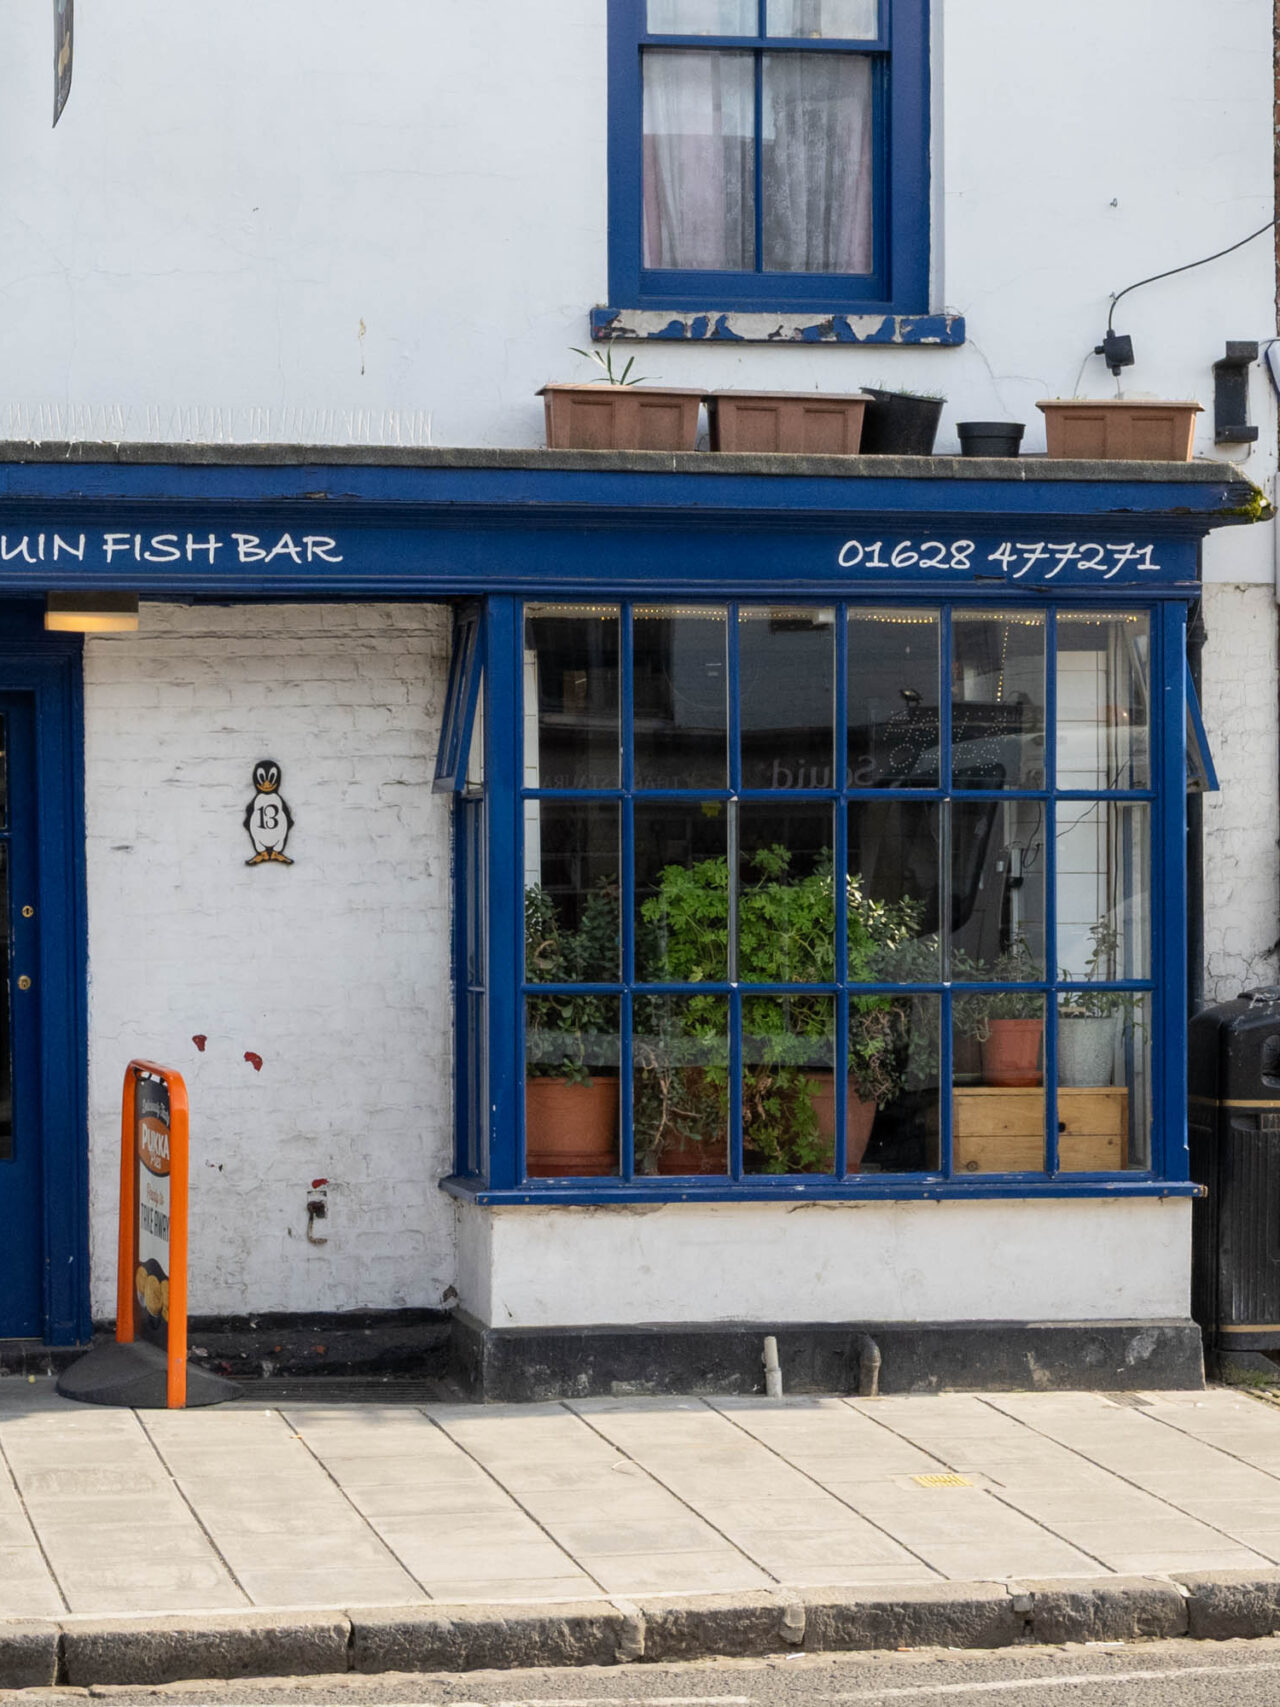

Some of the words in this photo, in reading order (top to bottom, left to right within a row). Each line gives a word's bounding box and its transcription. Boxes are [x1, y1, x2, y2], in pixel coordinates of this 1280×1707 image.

[102, 532, 224, 564] FISH
[231, 531, 344, 564] BAR
[838, 540, 976, 569] 01628
[987, 541, 1161, 579] 477271
[257, 803, 279, 830] 13
[142, 1121, 170, 1161] PUKKA
